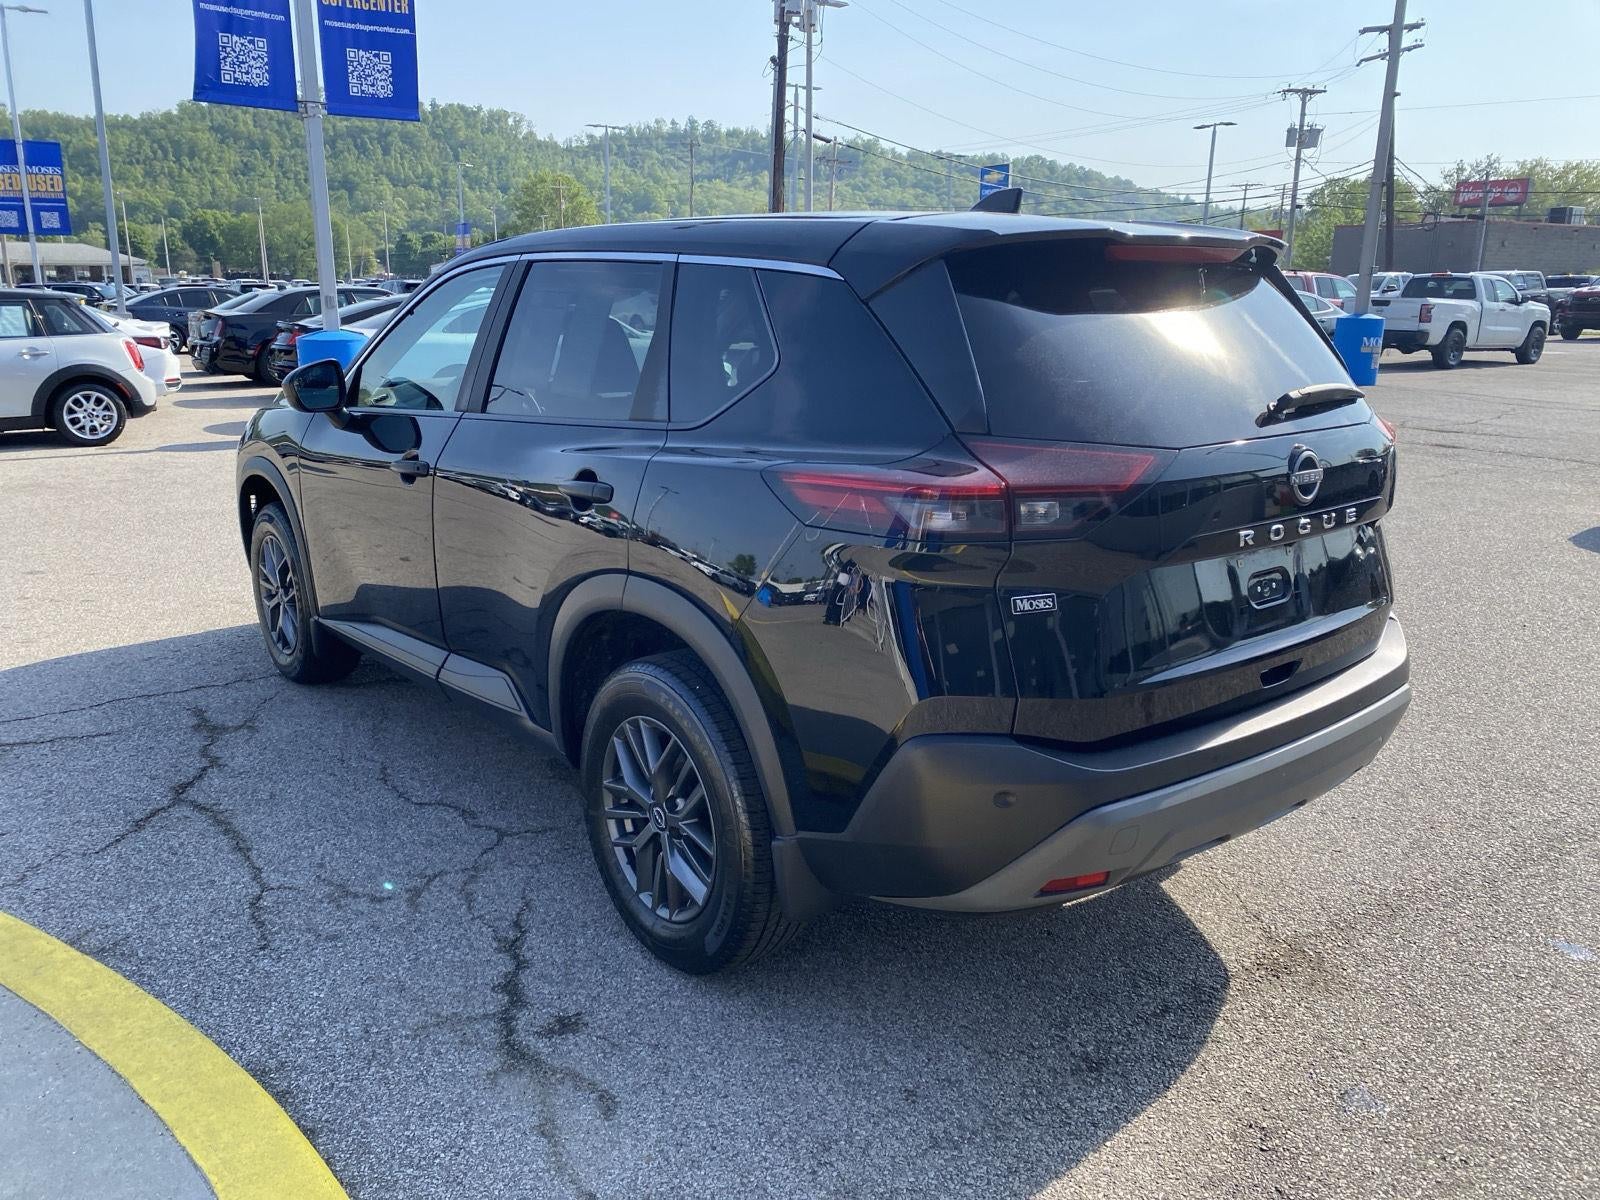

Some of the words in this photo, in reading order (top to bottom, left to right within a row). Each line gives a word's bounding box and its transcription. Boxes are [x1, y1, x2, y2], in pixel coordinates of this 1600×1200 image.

[199, 2, 286, 21] mosesusedsupercenter.com
[322, 0, 409, 14] ERCENTER
[323, 20, 411, 34] mosesusedsupercenter.com
[26, 165, 61, 174] MOSES
[27, 174, 63, 191] USED
[1239, 507, 1358, 547] ROGUE
[1016, 598, 1053, 611] MOSES
